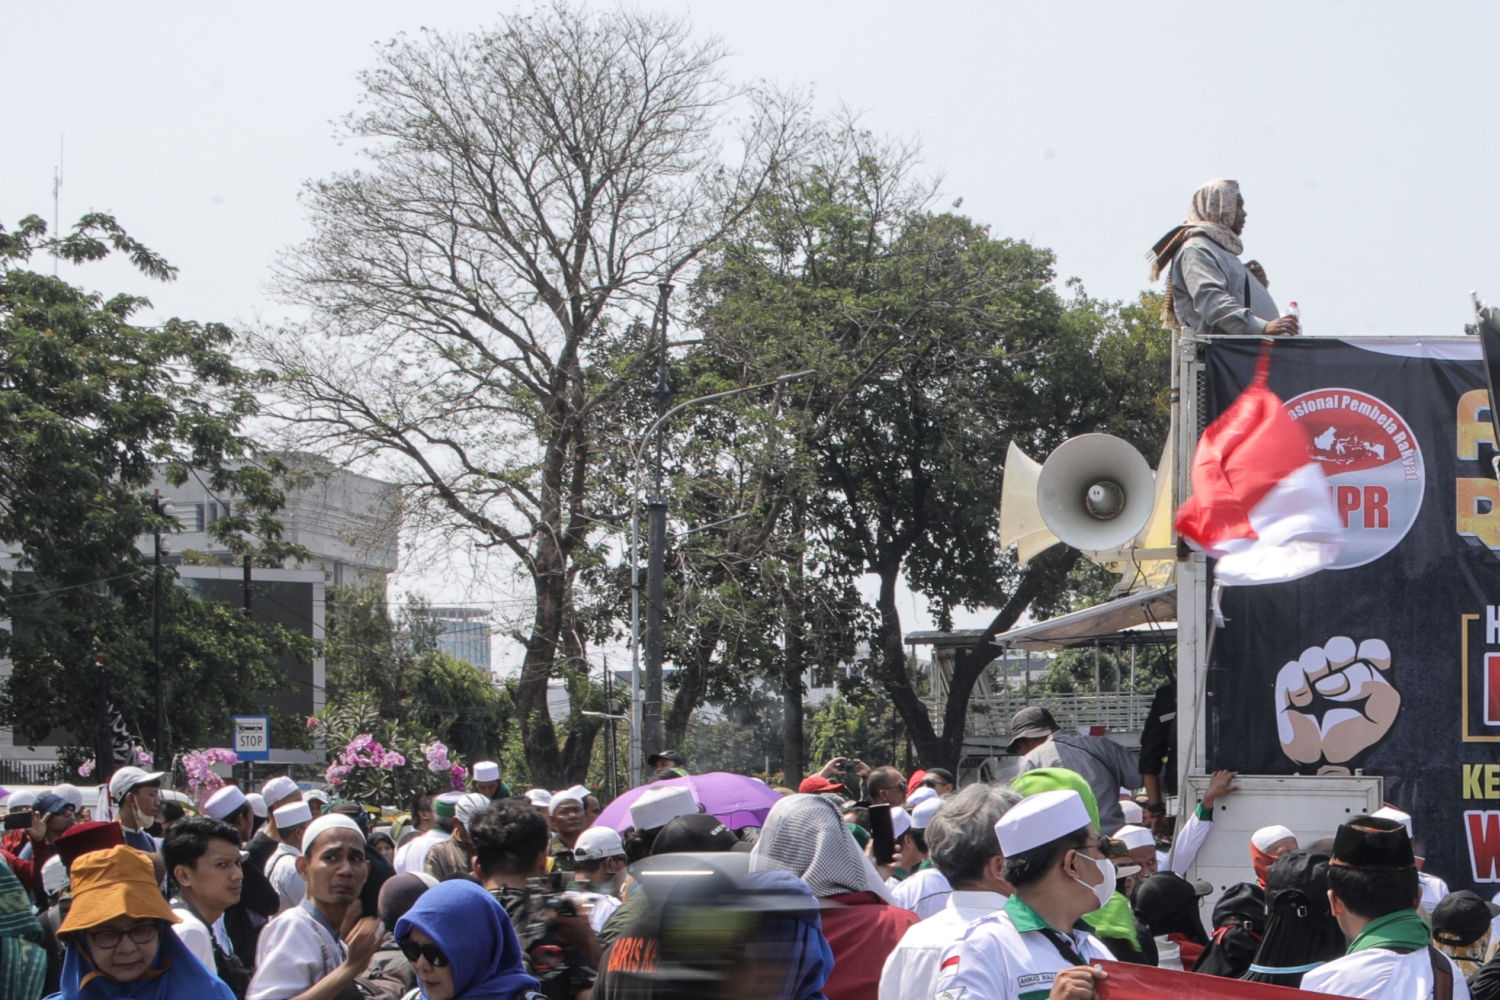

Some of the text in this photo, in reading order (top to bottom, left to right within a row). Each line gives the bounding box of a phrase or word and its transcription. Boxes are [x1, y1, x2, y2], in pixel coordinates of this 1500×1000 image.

[1289, 394, 1420, 481] asional Pembela Rakyat
[240, 735, 263, 748] STOP
